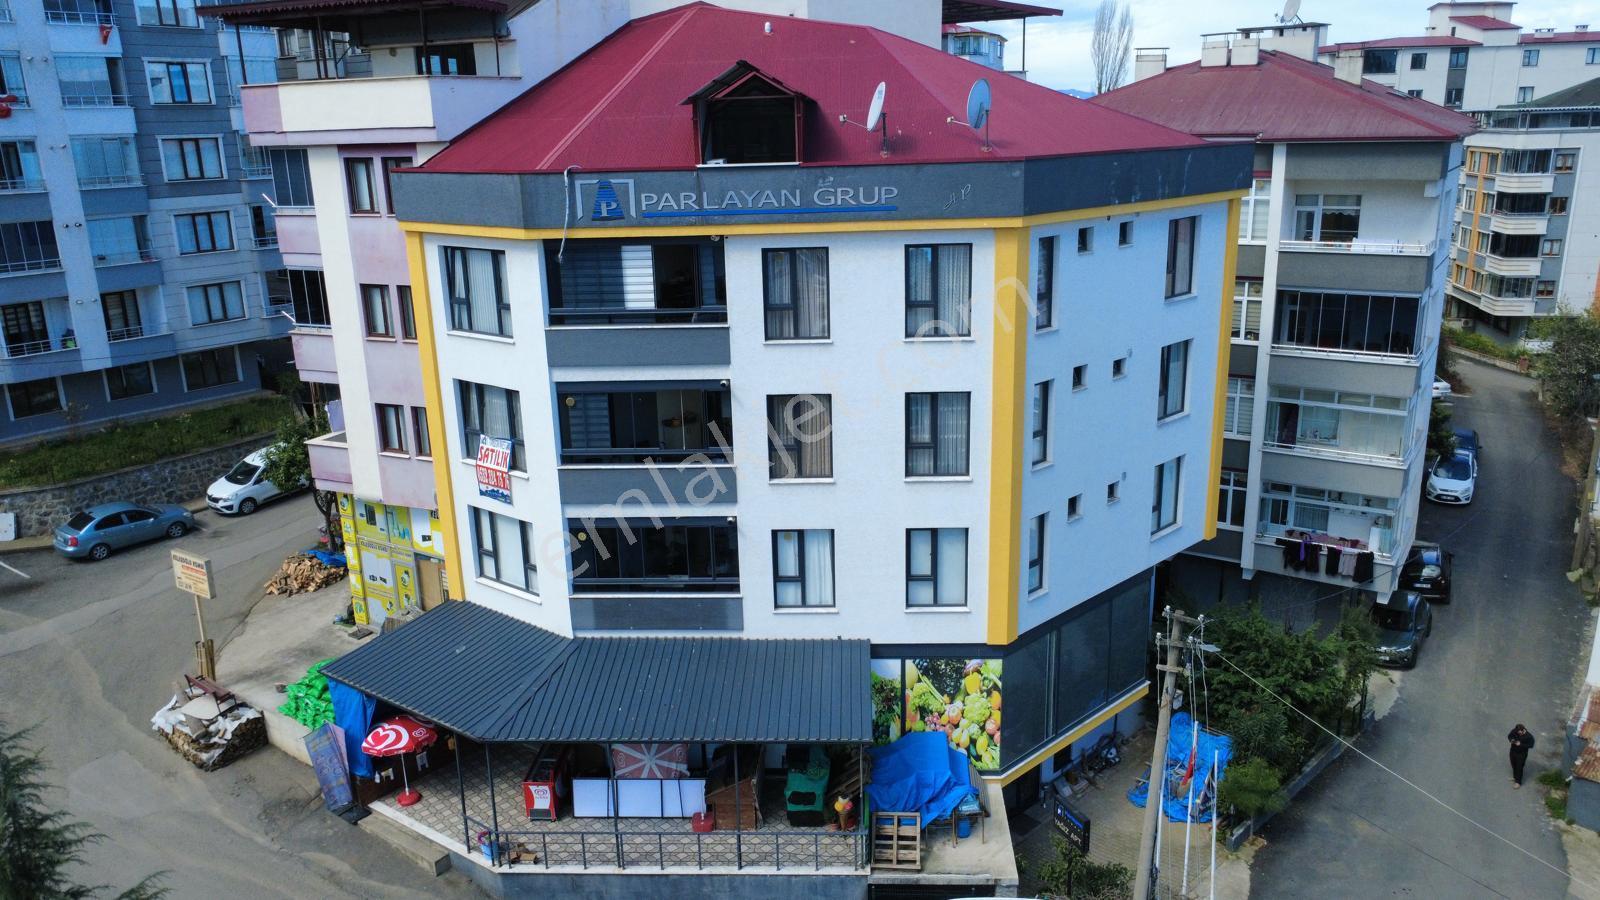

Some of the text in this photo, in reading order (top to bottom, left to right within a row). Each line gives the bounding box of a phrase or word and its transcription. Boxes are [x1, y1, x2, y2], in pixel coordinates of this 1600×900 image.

[641, 186, 898, 211] PARLAYAN GRUP
[478, 445, 509, 468] SATILIK
